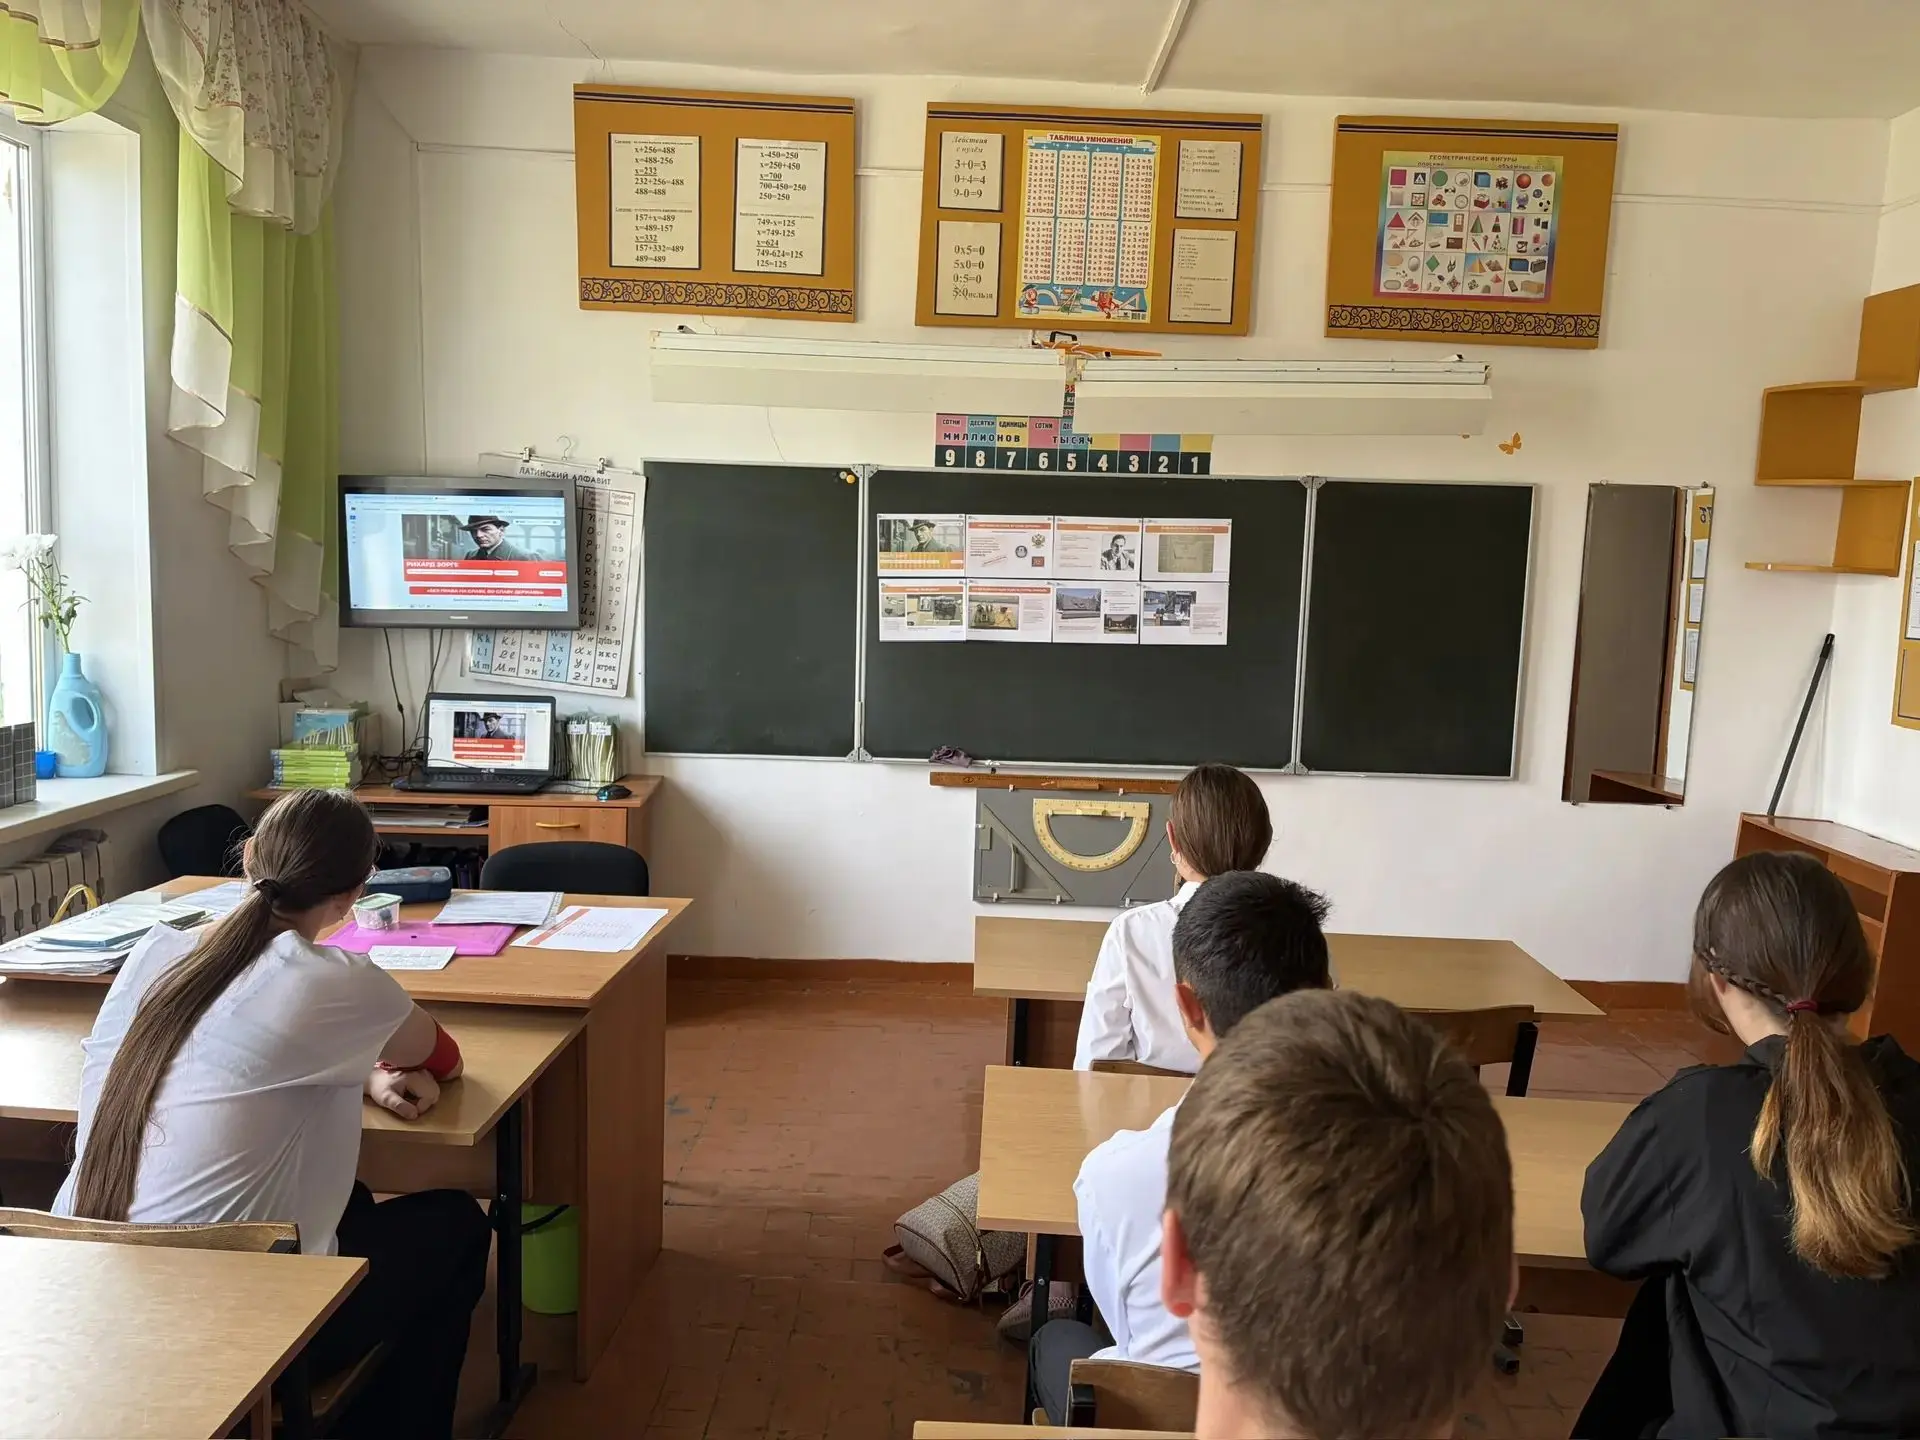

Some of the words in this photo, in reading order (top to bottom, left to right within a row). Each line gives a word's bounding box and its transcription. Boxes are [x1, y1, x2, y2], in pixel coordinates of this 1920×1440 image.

[1050, 134, 1084, 142] ТАБЛИЦА
[1086, 136, 1133, 144] УМНОЖЕНИЯ
[955, 160, 986, 170] 3+0=3
[955, 174, 985, 184] 0+4=4
[954, 188, 982, 198] 9-0=9
[954, 245, 984, 255] 0x5=0
[954, 260, 984, 269] 5x0=0
[953, 274, 981, 283] 0:5=0
[944, 432, 1020, 442] МИЛЛИОНОВ
[1052, 436, 1092, 445] ТЫСЯЧ
[945, 449, 955, 466] 9
[976, 450, 985, 467] 8
[1007, 451, 1016, 468] 7
[1038, 452, 1048, 469] 6
[1066, 453, 1076, 470] 5
[1098, 454, 1108, 471] 4
[1129, 455, 1139, 472] 3
[1158, 456, 1168, 472] 2
[1191, 456, 1198, 473] 1
[520, 467, 568, 479] ЛАТИНСКИЙ
[572, 474, 611, 485] АЛФАВИТ
